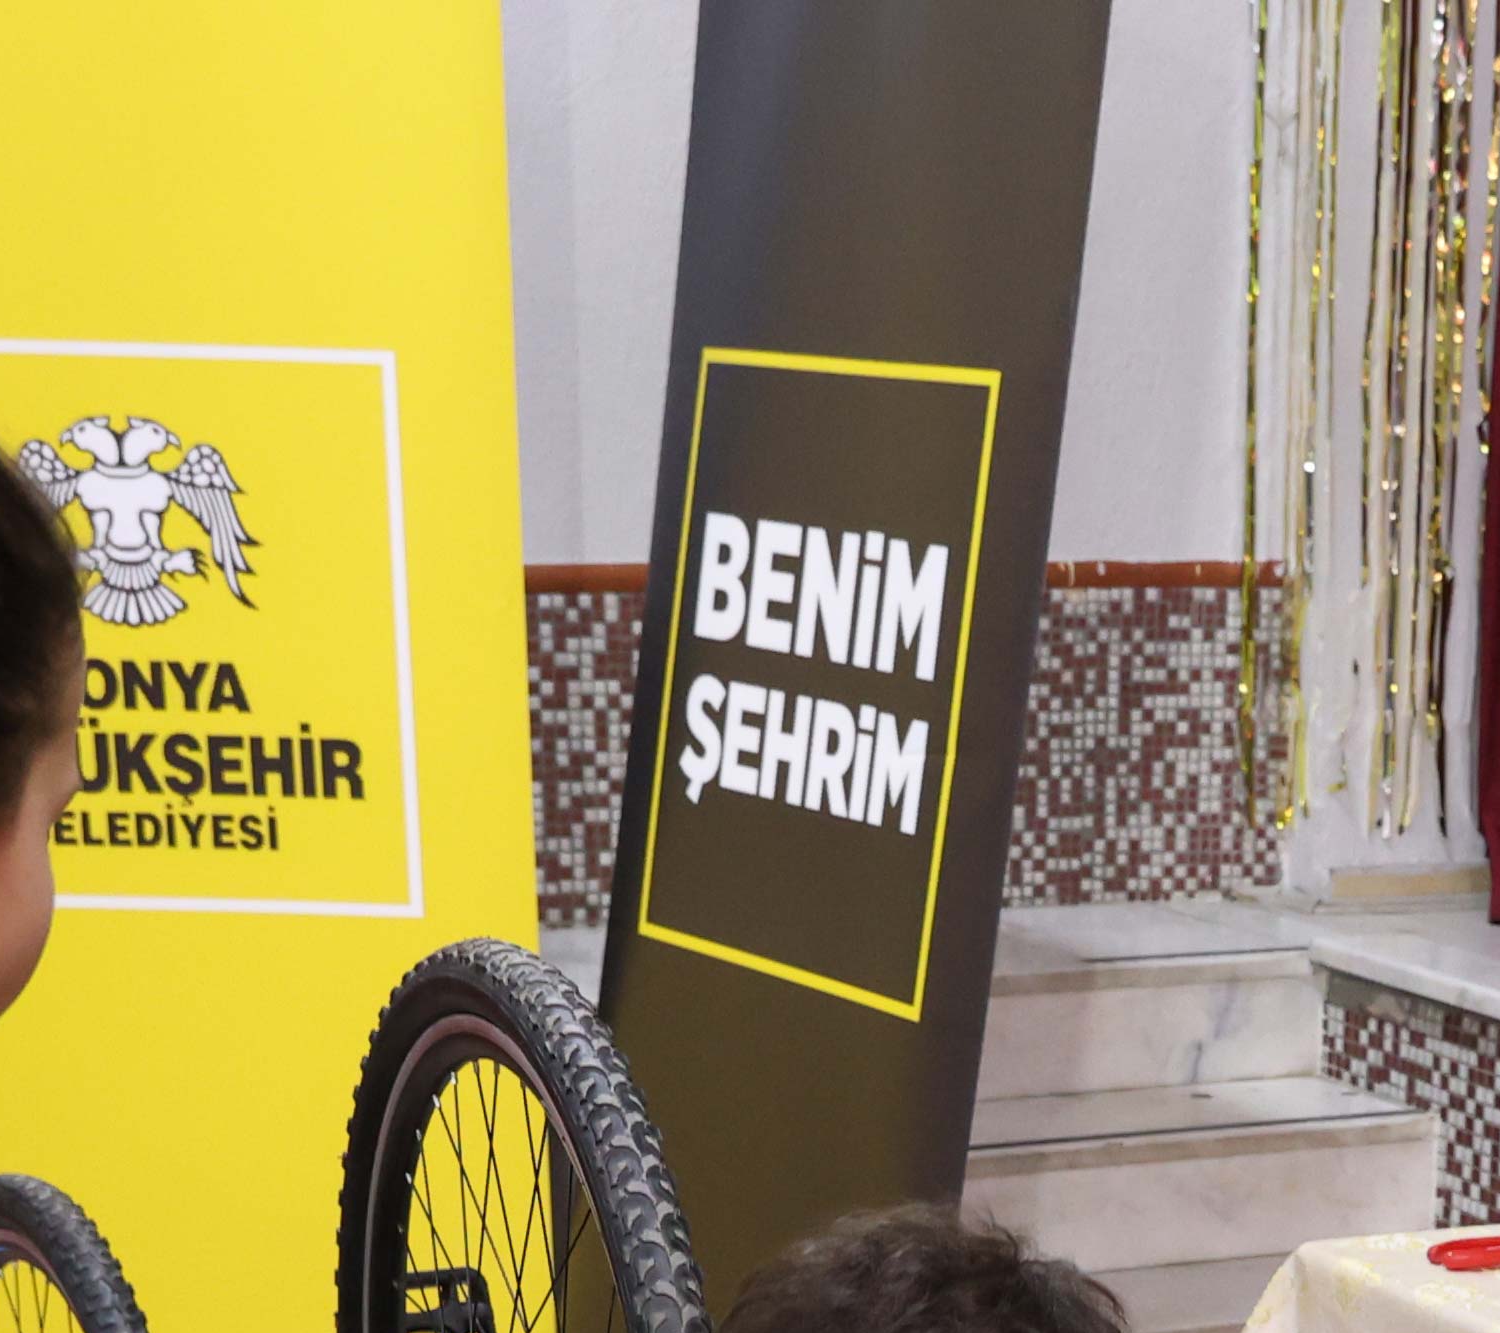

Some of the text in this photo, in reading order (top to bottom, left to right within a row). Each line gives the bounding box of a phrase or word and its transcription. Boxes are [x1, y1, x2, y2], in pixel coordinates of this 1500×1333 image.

[84, 658, 251, 714] ONYA
[76, 718, 366, 806] ÜKŞEHİR
[48, 803, 279, 851] ELEDİYESİ
